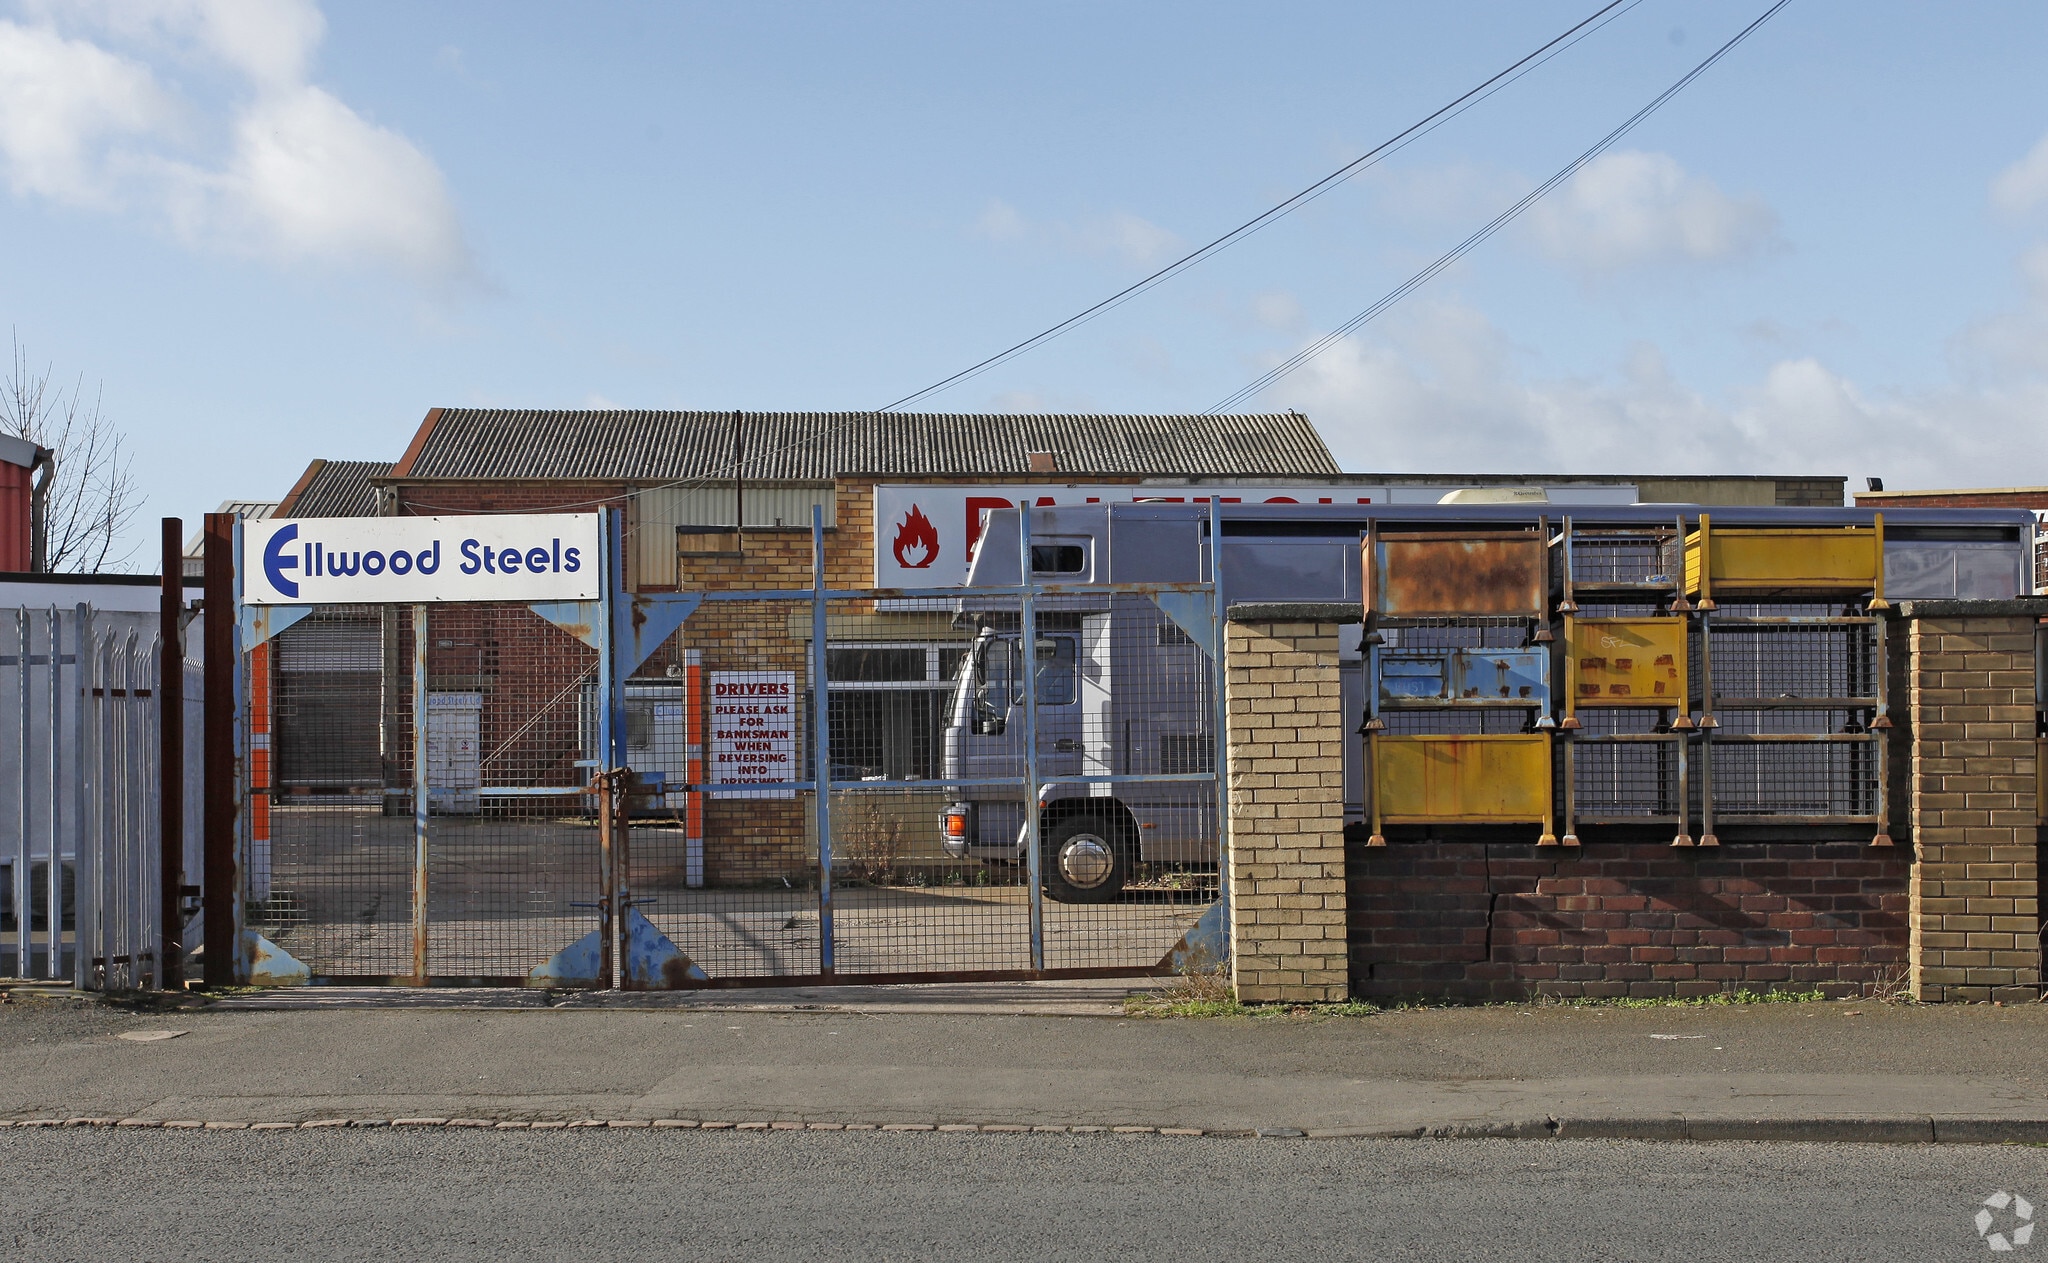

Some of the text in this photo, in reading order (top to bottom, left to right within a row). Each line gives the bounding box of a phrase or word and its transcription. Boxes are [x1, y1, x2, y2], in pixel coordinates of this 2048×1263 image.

[263, 523, 581, 598] Ellwood Steels
[716, 683, 789, 695] DRIVERS
[716, 705, 788, 714] PLEASE ASK
[740, 718, 764, 726] FOR
[717, 730, 788, 739] BANKSMAN
[735, 742, 771, 750] WHEN
[718, 754, 787, 762] REVERSING
[738, 766, 767, 774] INTO
